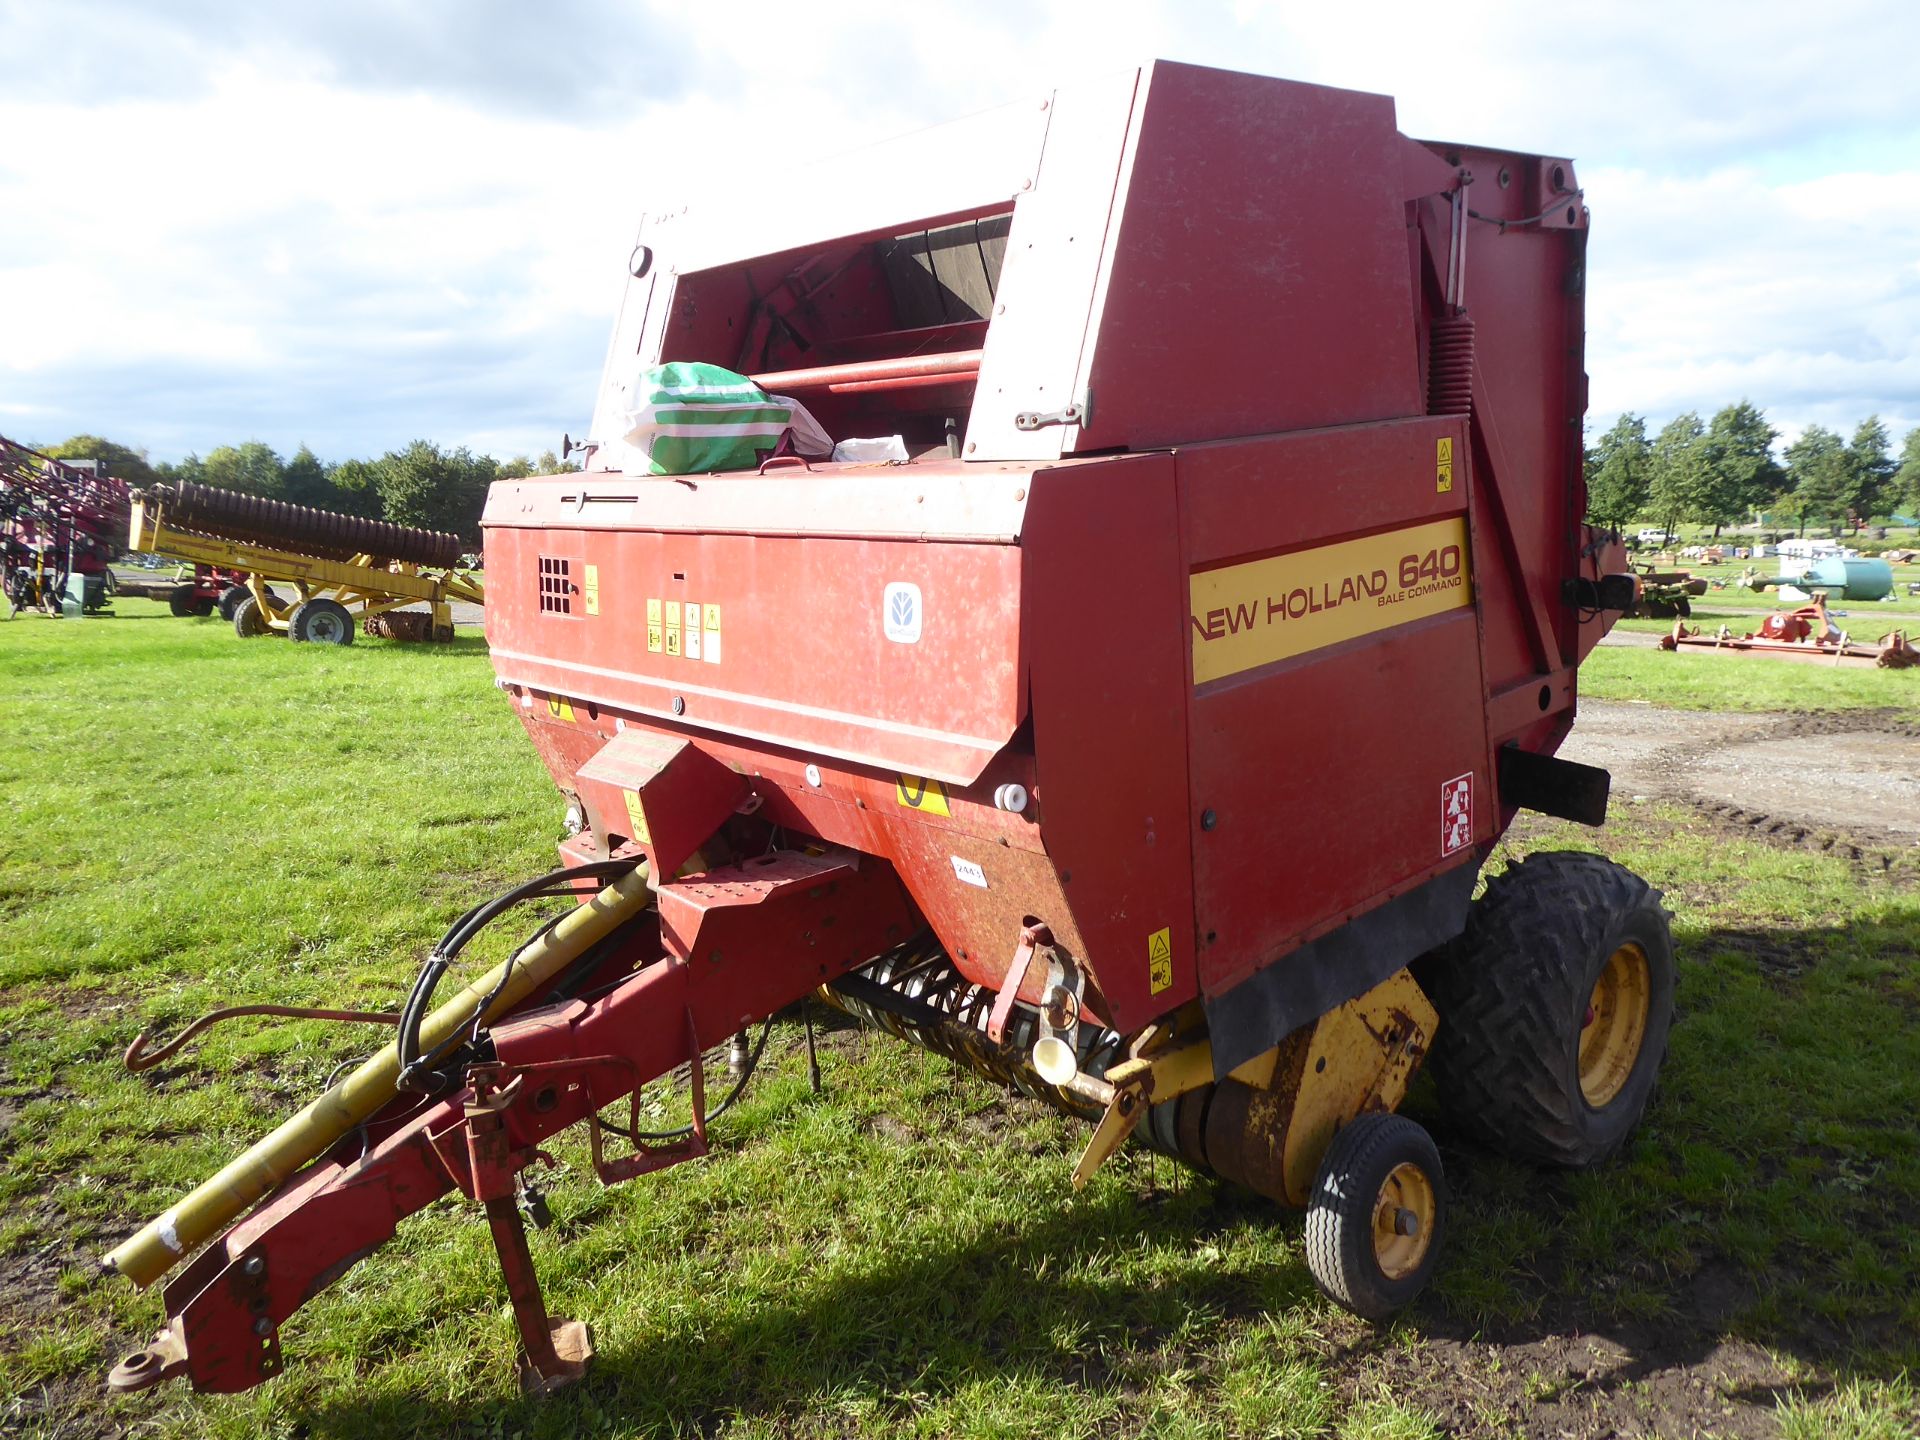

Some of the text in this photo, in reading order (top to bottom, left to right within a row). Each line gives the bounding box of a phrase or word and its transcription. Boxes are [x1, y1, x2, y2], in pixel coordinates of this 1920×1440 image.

[1267, 569, 1388, 625] HOLLAND
[1398, 544, 1460, 589] 640
[1377, 576, 1462, 607] BALE COMMAND
